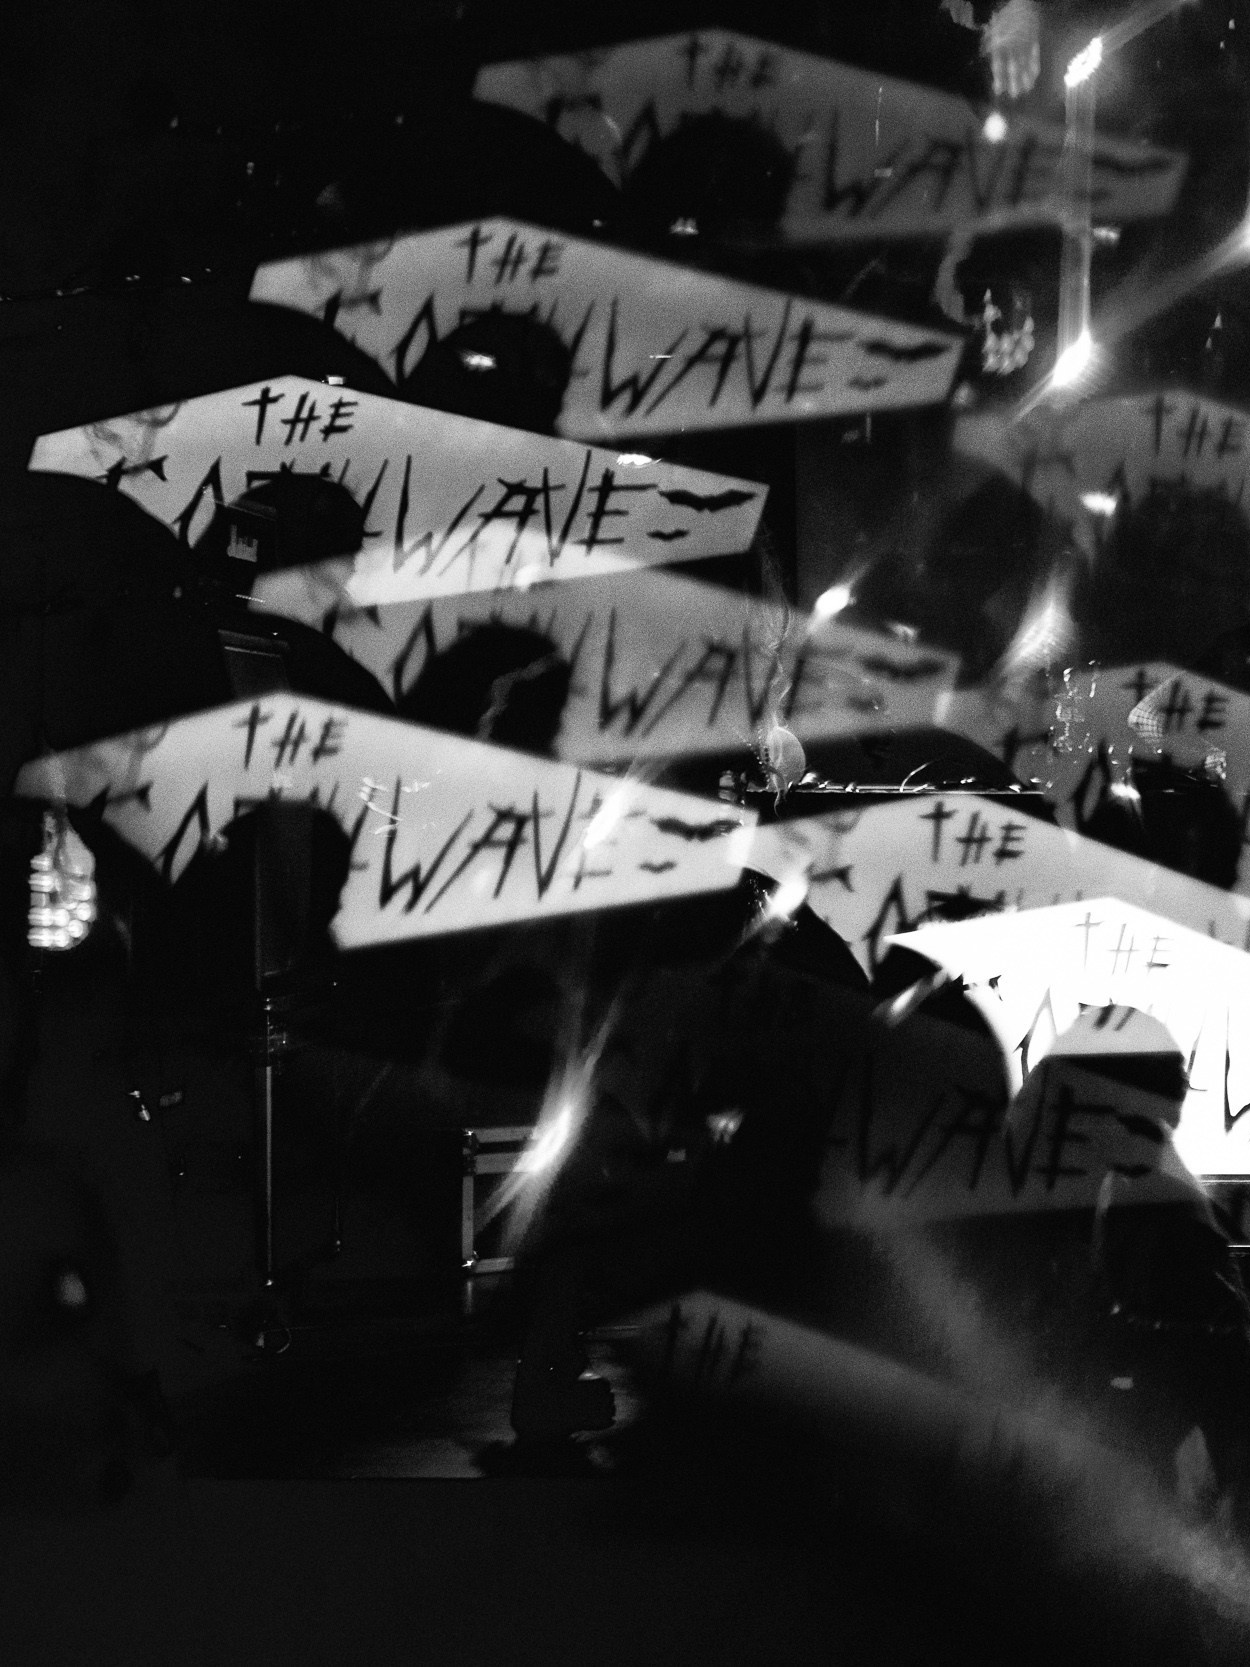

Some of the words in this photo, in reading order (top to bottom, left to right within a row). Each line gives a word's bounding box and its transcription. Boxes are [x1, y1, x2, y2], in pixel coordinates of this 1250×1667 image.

[452, 225, 566, 287] THE
[240, 386, 360, 449] THE
[1147, 395, 1245, 462] THE
[230, 702, 350, 773] THE
[918, 801, 1028, 867] THE
[1075, 911, 1176, 977] THE
